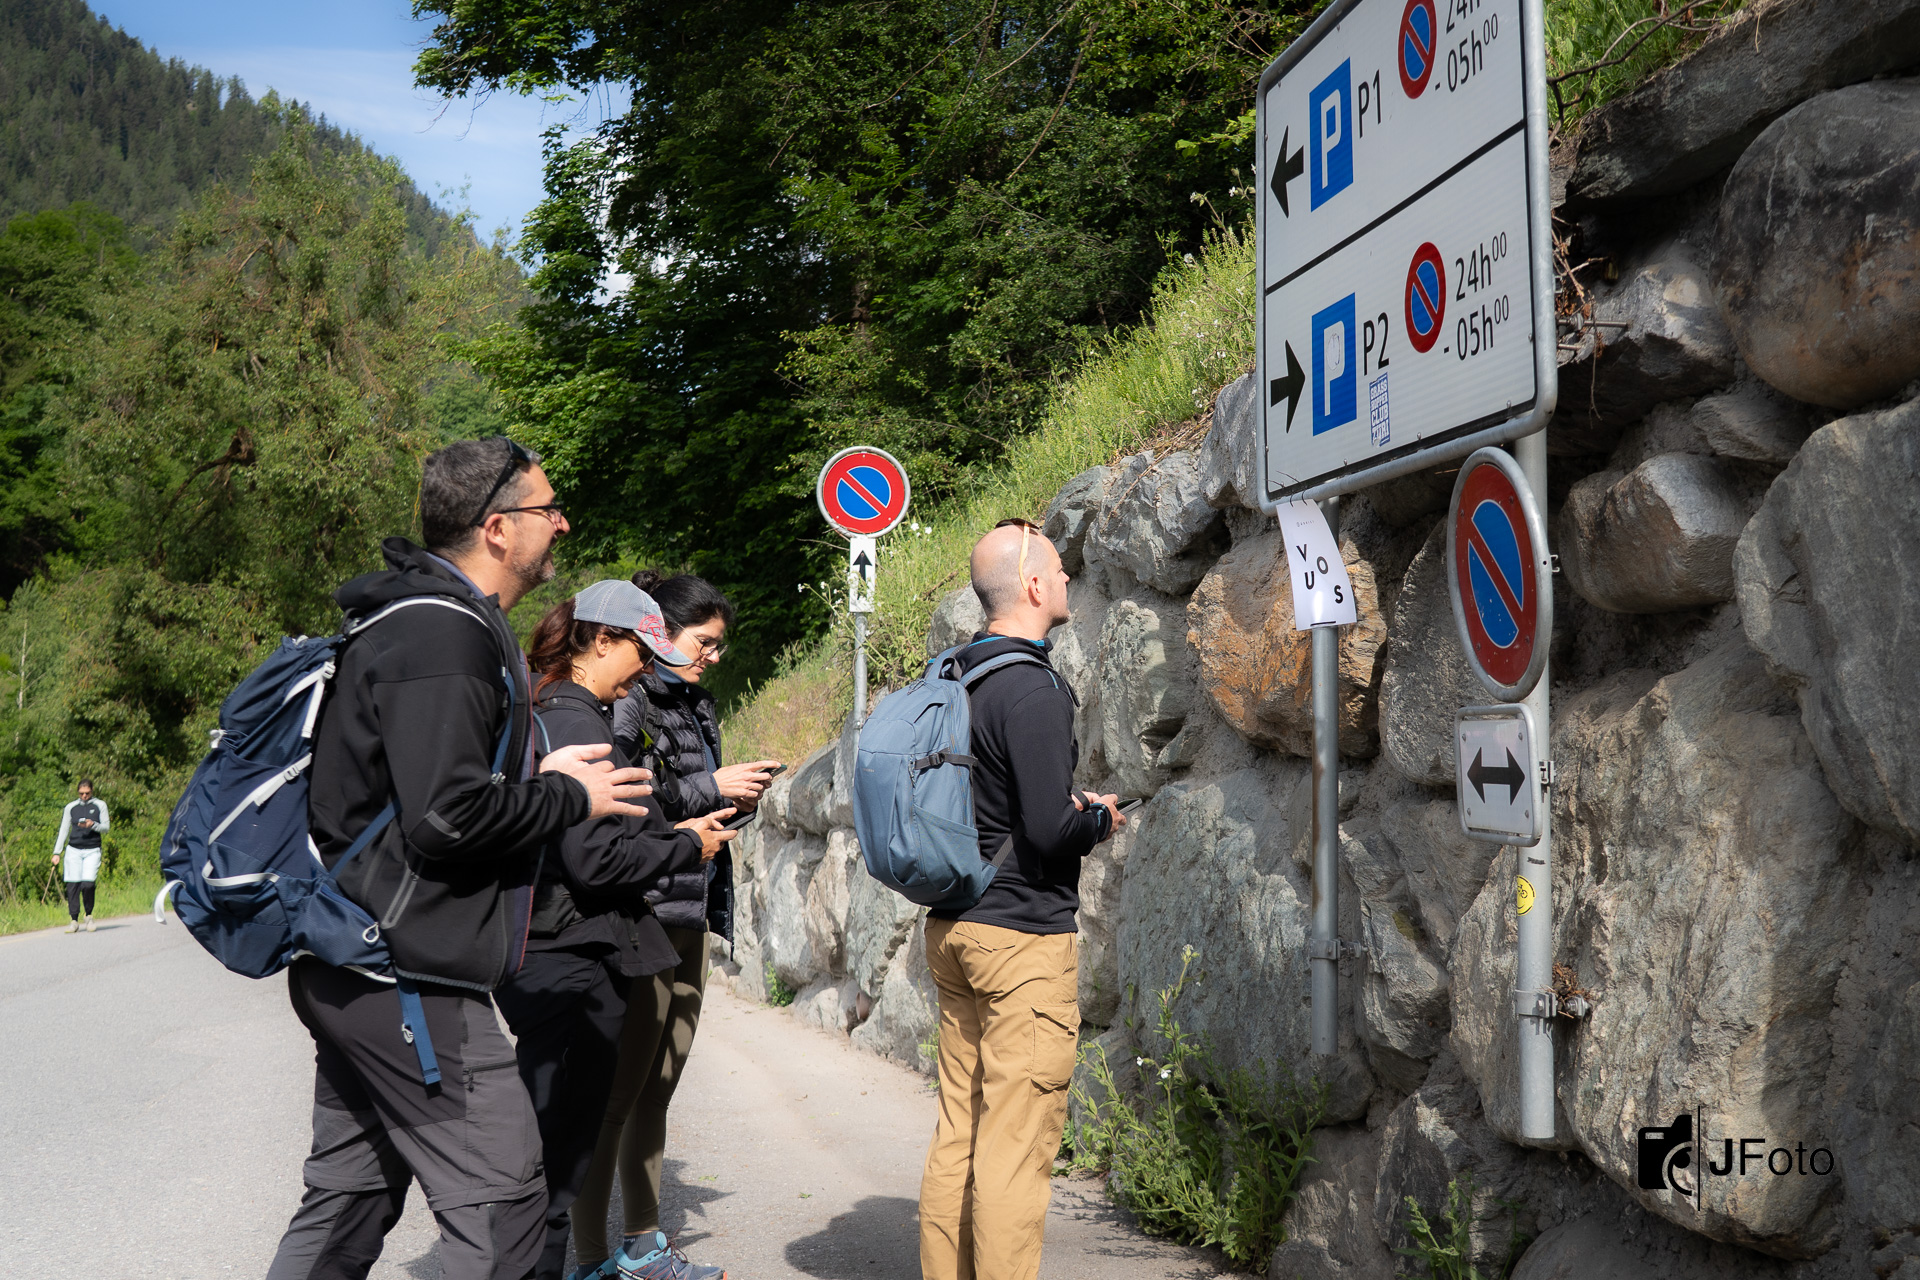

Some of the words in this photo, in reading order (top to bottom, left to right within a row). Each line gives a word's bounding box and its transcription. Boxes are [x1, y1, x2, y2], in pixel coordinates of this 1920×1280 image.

[1358, 68, 1381, 139] P1
[1363, 311, 1389, 376] P2
[1371, 402, 1389, 426] CLUB
